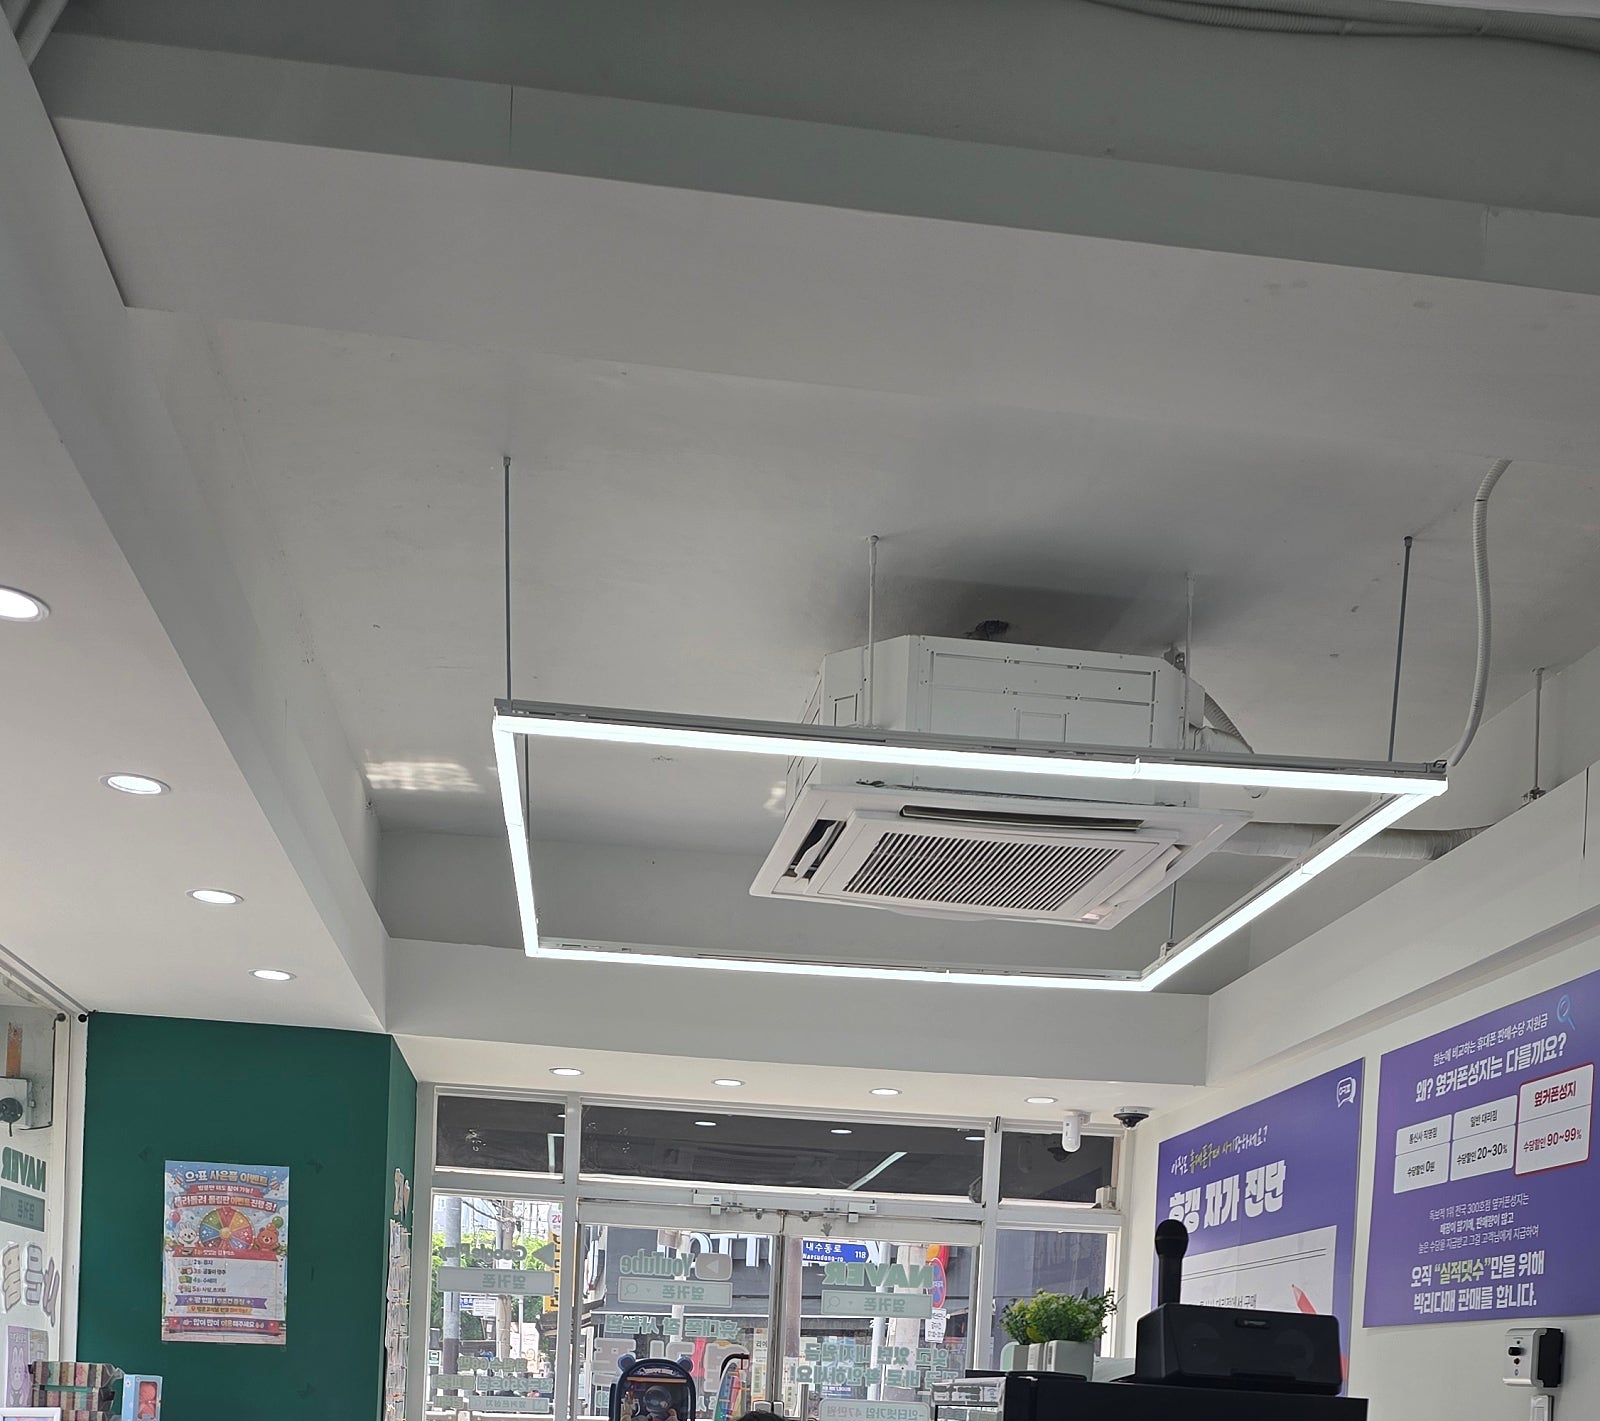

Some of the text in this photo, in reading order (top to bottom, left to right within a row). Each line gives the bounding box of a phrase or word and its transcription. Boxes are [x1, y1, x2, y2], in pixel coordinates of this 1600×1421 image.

[1433, 1013, 1548, 1066] 한눈에 비교하는 휴대폰 판매수당 지원금
[1416, 1032, 1567, 1102] 왜? 옆커폰성지는 다를까요?
[1534, 1081, 1577, 1107] 옆커폰성지
[1470, 1110, 1498, 1128] 일반 대리점
[1409, 1127, 1437, 1144] 통신사 직영점
[1523, 1127, 1582, 1152] 수당할인 90~99%
[1457, 1143, 1508, 1166] 수당할인 20~30%
[210, 1170, 238, 1182] 사은품
[240, 1172, 268, 1186] 이벤트
[1407, 1160, 1435, 1178] 수당할인 0원
[231, 1196, 250, 1207] 이벤트
[1169, 1159, 1287, 1234] 호갱 자가 진단
[1455, 1204, 1466, 1217] 전국
[1467, 1200, 1491, 1215] 300호점
[1492, 1193, 1529, 1211] 옆커폰성지는
[1501, 1212, 1514, 1226] 많고
[806, 1242, 842, 1254] 내수동로
[1418, 1224, 1539, 1254] 높은 수당을 지급받고 그걸 고객님에게 지급하여
[855, 1251, 867, 1259] 118
[1411, 1264, 1432, 1287] 오직
[1518, 1250, 1545, 1276] 위해
[1413, 1282, 1537, 1314] 박리다매 판매를 합니다.
[193, 1318, 206, 1327] 많이
[207, 1318, 219, 1327] 많이
